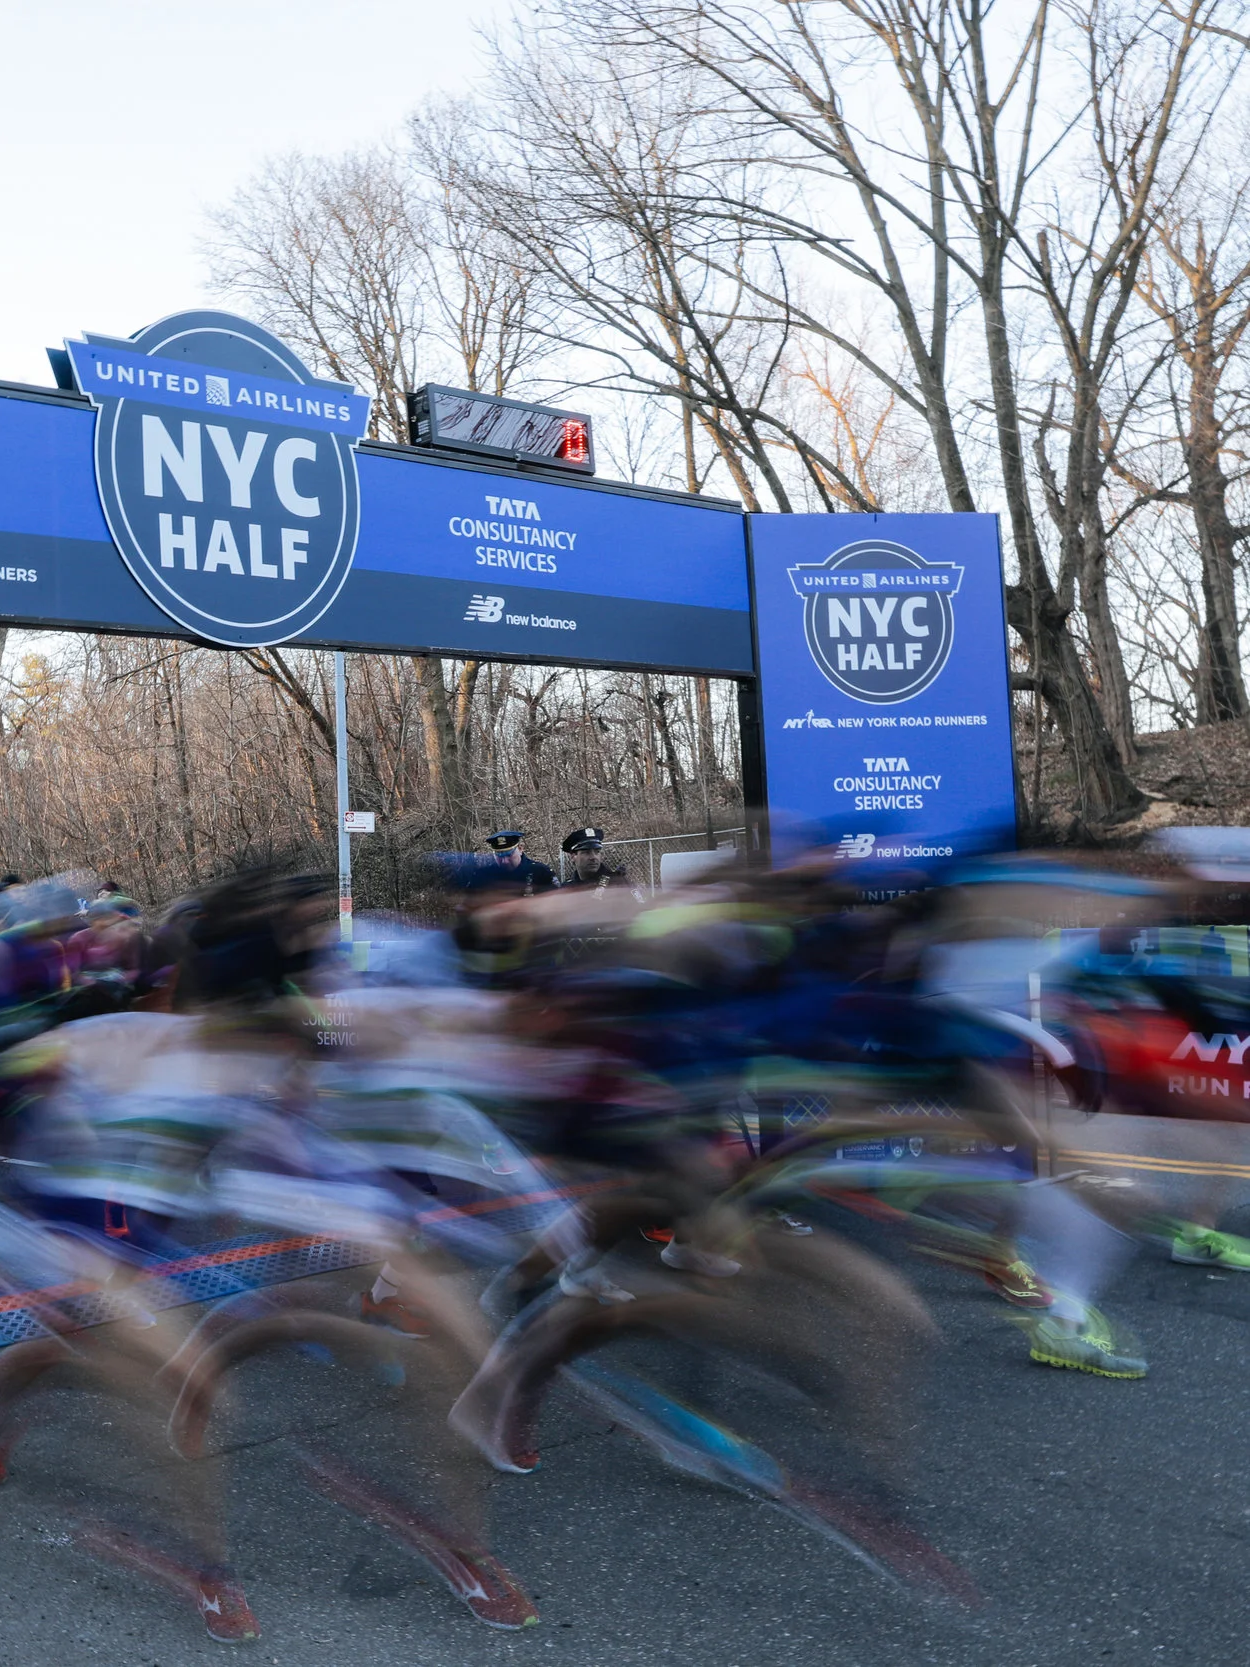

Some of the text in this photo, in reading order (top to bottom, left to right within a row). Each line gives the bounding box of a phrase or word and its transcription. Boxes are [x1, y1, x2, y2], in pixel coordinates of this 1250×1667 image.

[96, 361, 351, 422] UNITED AIRLINES
[141, 414, 321, 518] NYC
[485, 495, 541, 521] TATA
[449, 516, 577, 550] CONSULTANCY
[158, 512, 310, 581] HALF
[475, 546, 557, 573] SERVICES
[803, 574, 949, 586] UNITED AIRLINES
[506, 613, 529, 626] new
[531, 613, 577, 631] balance
[827, 596, 930, 638] NYC
[837, 643, 923, 671] HALF
[837, 717, 864, 728] NEW
[867, 717, 897, 728] YORK
[900, 716, 932, 727] ROAD
[934, 715, 988, 727] RUNNERS
[863, 757, 910, 772] TATA
[833, 775, 942, 792] CONSULTANCY
[854, 795, 923, 811] SERVICES
[876, 847, 901, 858] new
[903, 845, 953, 858] balance
[1168, 1075, 1230, 1097] RUN
